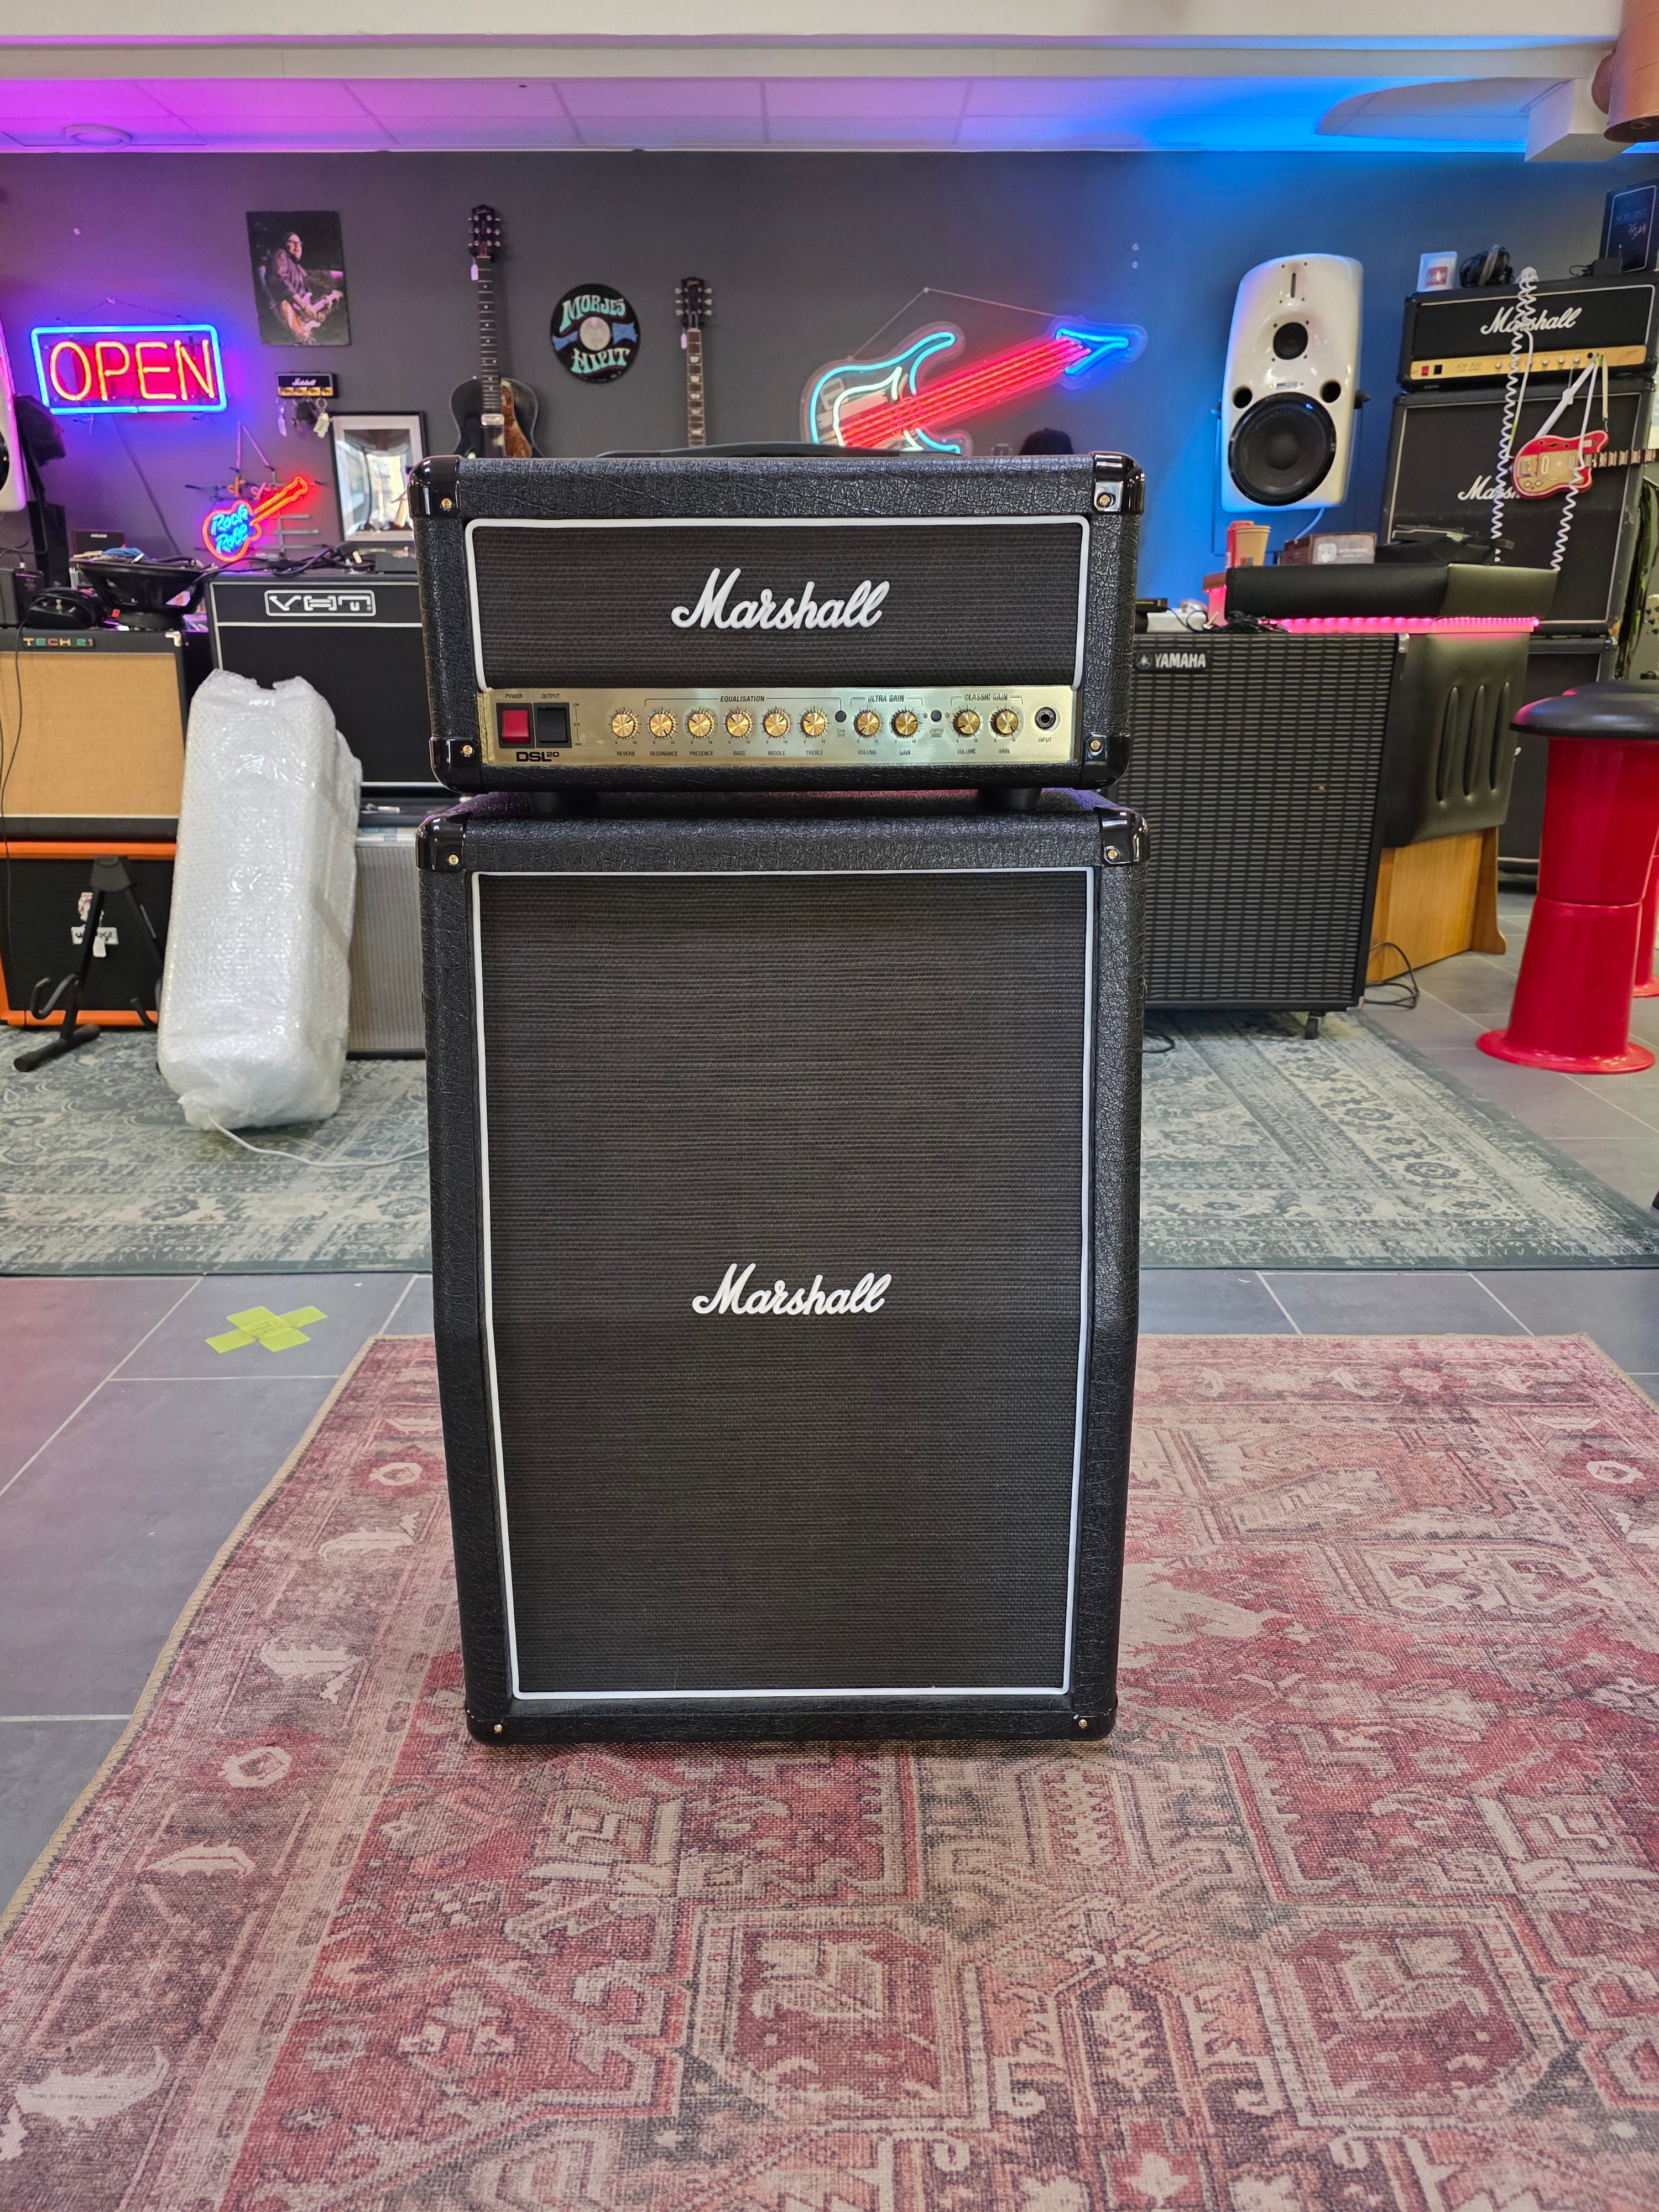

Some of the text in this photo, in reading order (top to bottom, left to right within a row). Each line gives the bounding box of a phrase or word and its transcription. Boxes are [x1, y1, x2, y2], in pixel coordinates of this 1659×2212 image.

[559, 295, 625, 332] MORJES
[50, 339, 215, 401] OPEN
[211, 504, 248, 536] Rock
[215, 524, 249, 554] Roll
[269, 596, 372, 611] VHT
[671, 567, 890, 629] Marshall
[23, 638, 93, 646] TECH 21
[1155, 653, 1206, 668] YAMAHA
[692, 1263, 892, 1315] Marshall
